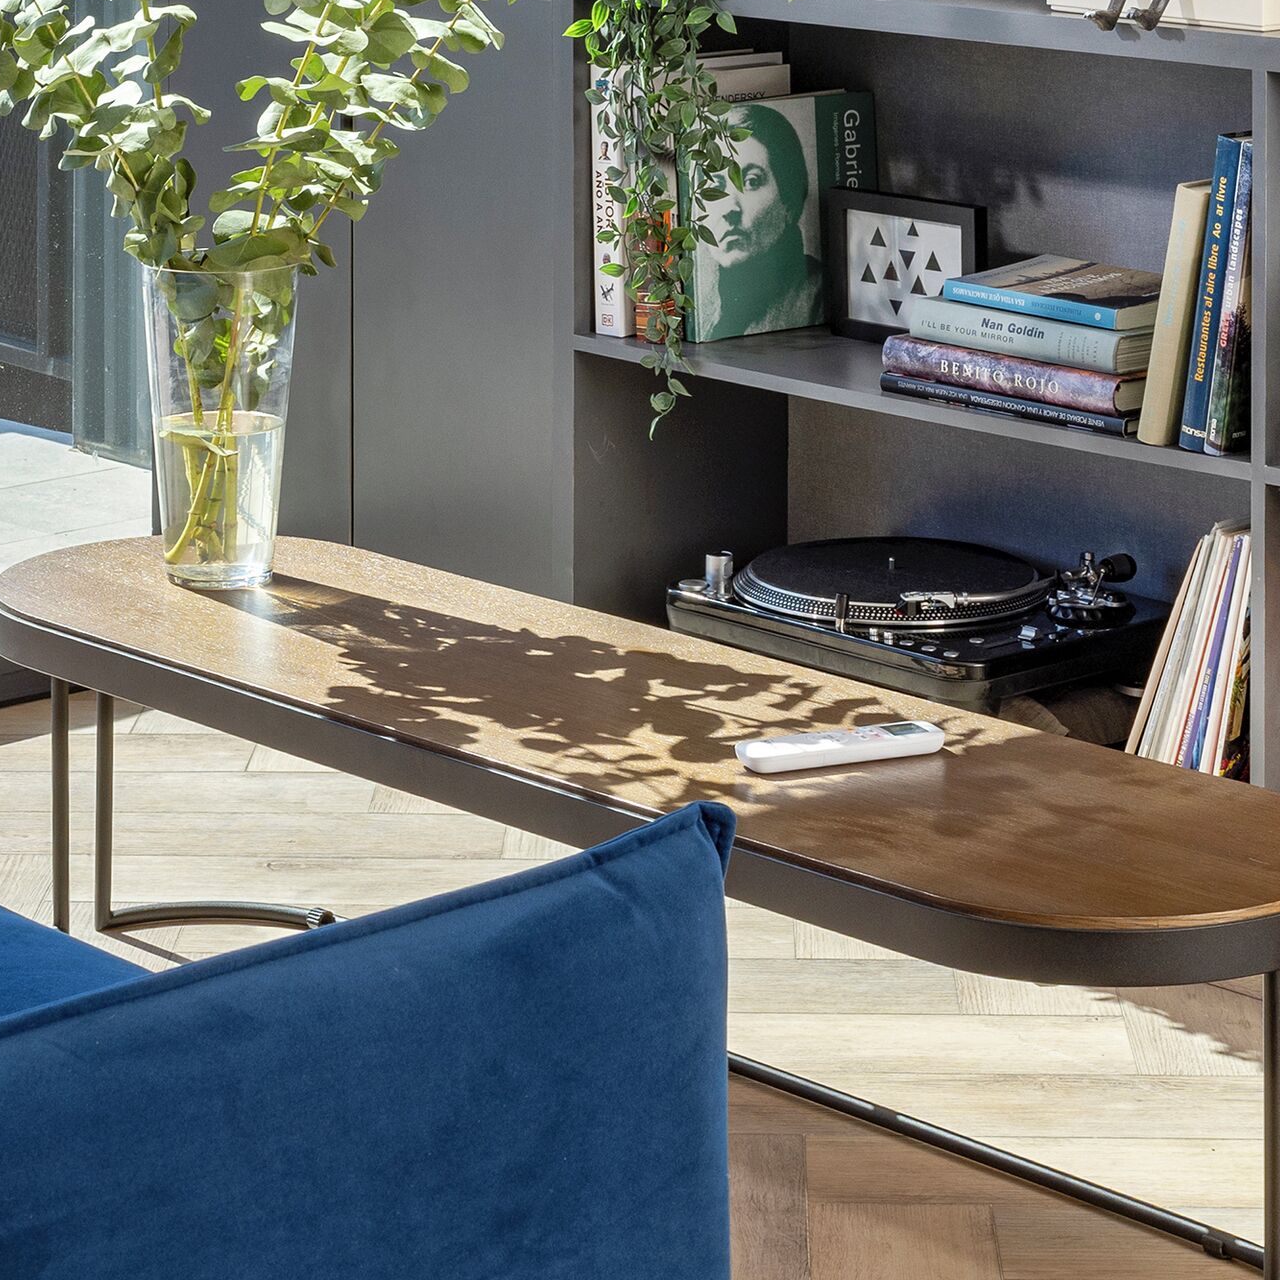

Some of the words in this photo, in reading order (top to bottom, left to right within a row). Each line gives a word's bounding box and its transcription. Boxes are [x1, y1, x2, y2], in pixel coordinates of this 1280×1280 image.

[843, 109, 862, 188] Gabrie
[595, 170, 605, 199] AÑO
[1216, 176, 1227, 202] livre
[596, 203, 603, 211] A
[1215, 204, 1224, 216] ar
[1212, 223, 1222, 238] Ao
[1229, 208, 1243, 271] landscapes
[1207, 244, 1219, 270] libre
[1206, 272, 1216, 294] aire
[1225, 275, 1234, 308] urban
[1203, 296, 1213, 308] al
[921, 320, 937, 329] I'LL
[940, 323, 951, 332] BE
[954, 326, 978, 337] YOUR
[981, 331, 1015, 344] MIRROR
[981, 317, 1003, 332] Nan
[1007, 322, 1045, 340] Goldin
[1194, 310, 1212, 382] Restaurantes
[940, 359, 1005, 384] BENITO
[1014, 373, 1059, 394] ROJO
[1043, 409, 1058, 419] AMOR
[1058, 412, 1066, 420] DE
[1067, 414, 1088, 425] POEMAS
[1088, 418, 1105, 428] VEINTE
